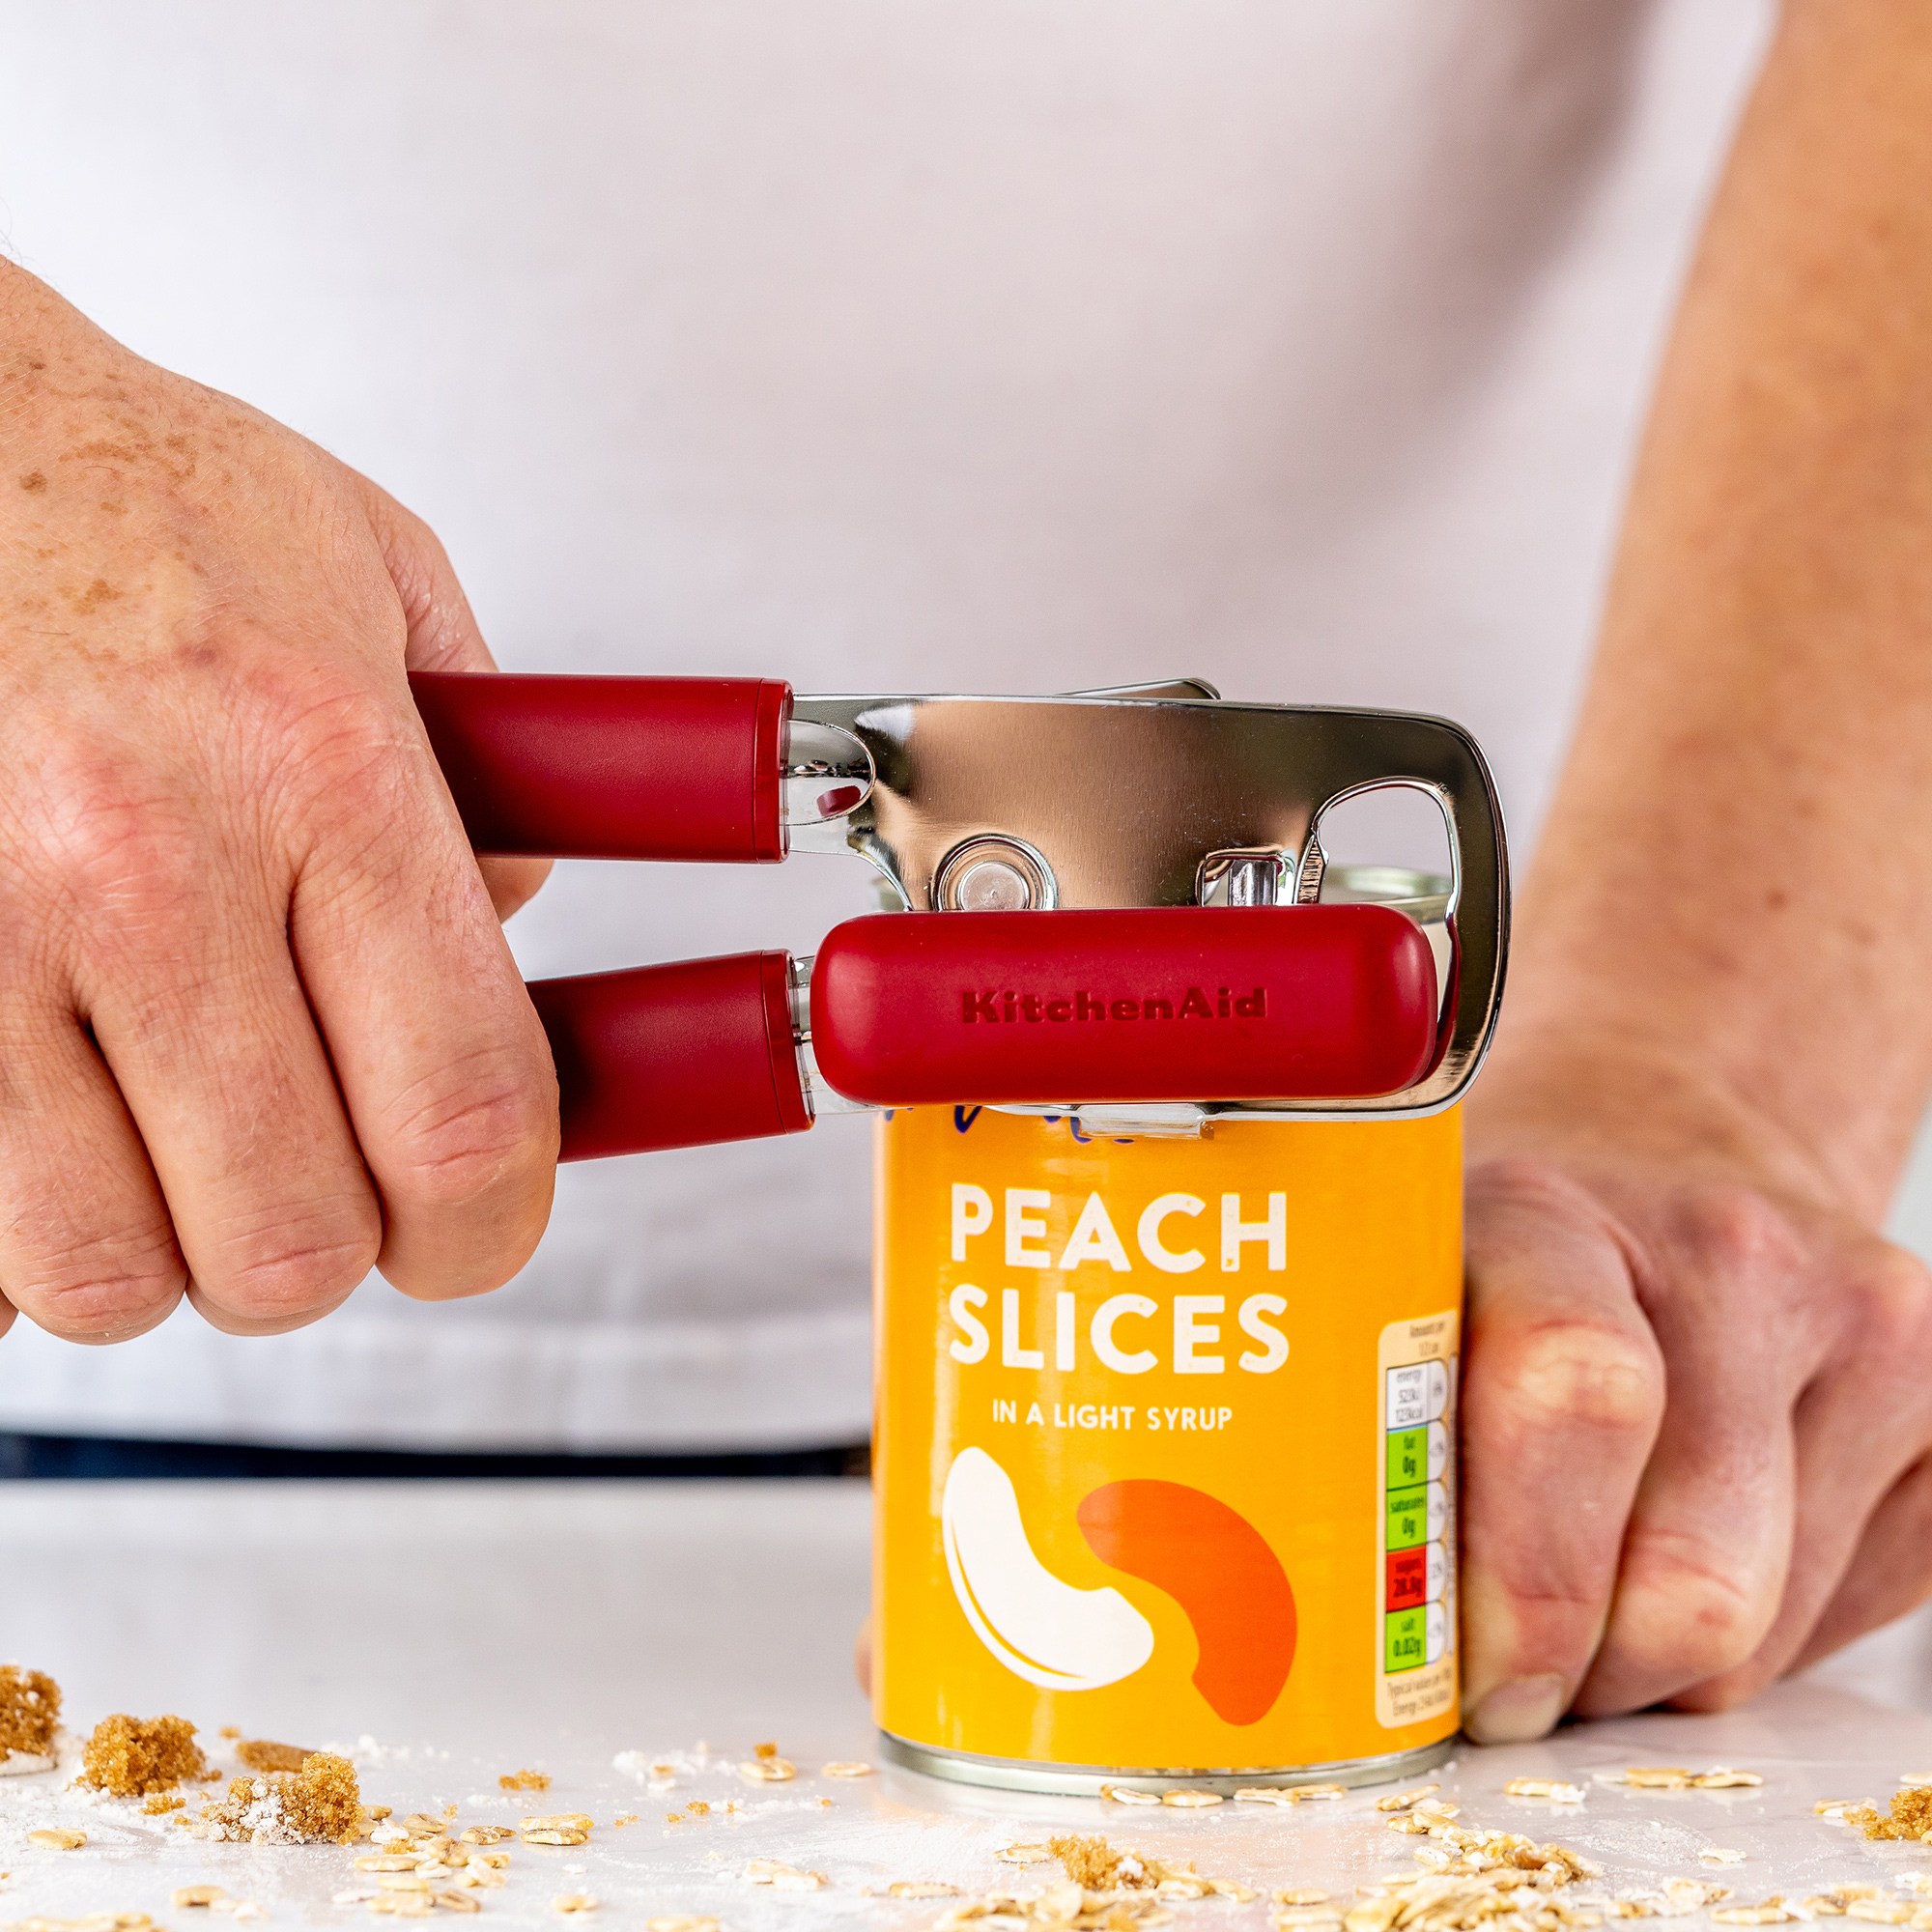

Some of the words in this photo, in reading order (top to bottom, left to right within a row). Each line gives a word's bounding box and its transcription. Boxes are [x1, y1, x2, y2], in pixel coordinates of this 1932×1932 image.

[962, 987, 1267, 1023] KitchenAid
[952, 1183, 1287, 1273] PEACH
[949, 1284, 1290, 1374] SLICES
[993, 1399, 1016, 1424] IN
[1026, 1402, 1045, 1426] A
[1054, 1404, 1136, 1430] LIGHT
[1147, 1406, 1233, 1431] SYRUP
